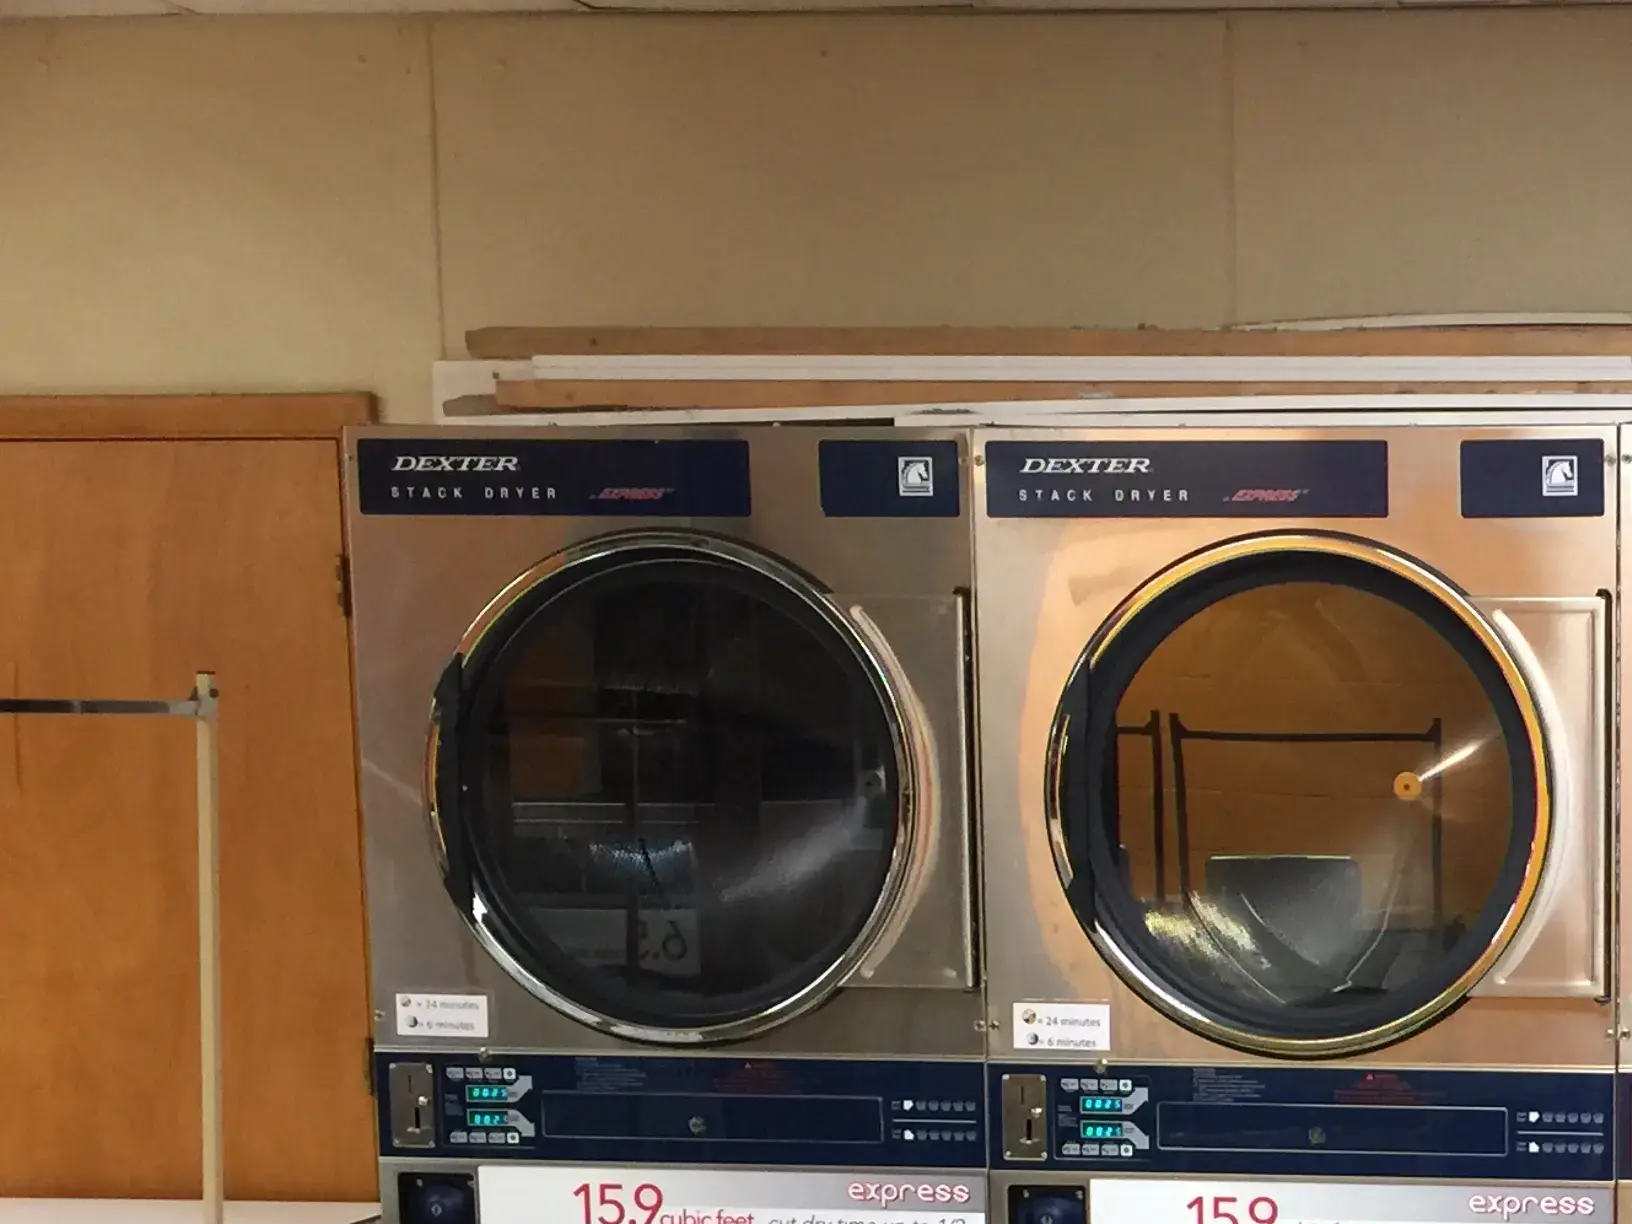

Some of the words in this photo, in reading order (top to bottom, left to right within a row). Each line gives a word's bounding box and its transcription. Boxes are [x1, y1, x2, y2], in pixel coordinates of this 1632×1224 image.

[393, 457, 518, 470] DEXTER
[1022, 458, 1151, 473] DEXTER
[393, 487, 463, 498] STACK
[486, 487, 556, 498] DRYER
[1020, 490, 1093, 501] STACK
[1116, 490, 1188, 501] DRYER
[1046, 1016, 1058, 1026] 24
[1060, 1017, 1101, 1027] minutes
[1047, 1037, 1054, 1047] 6
[1056, 1039, 1097, 1048] minutes
[847, 1181, 971, 1208] express
[1469, 1193, 1595, 1220] express
